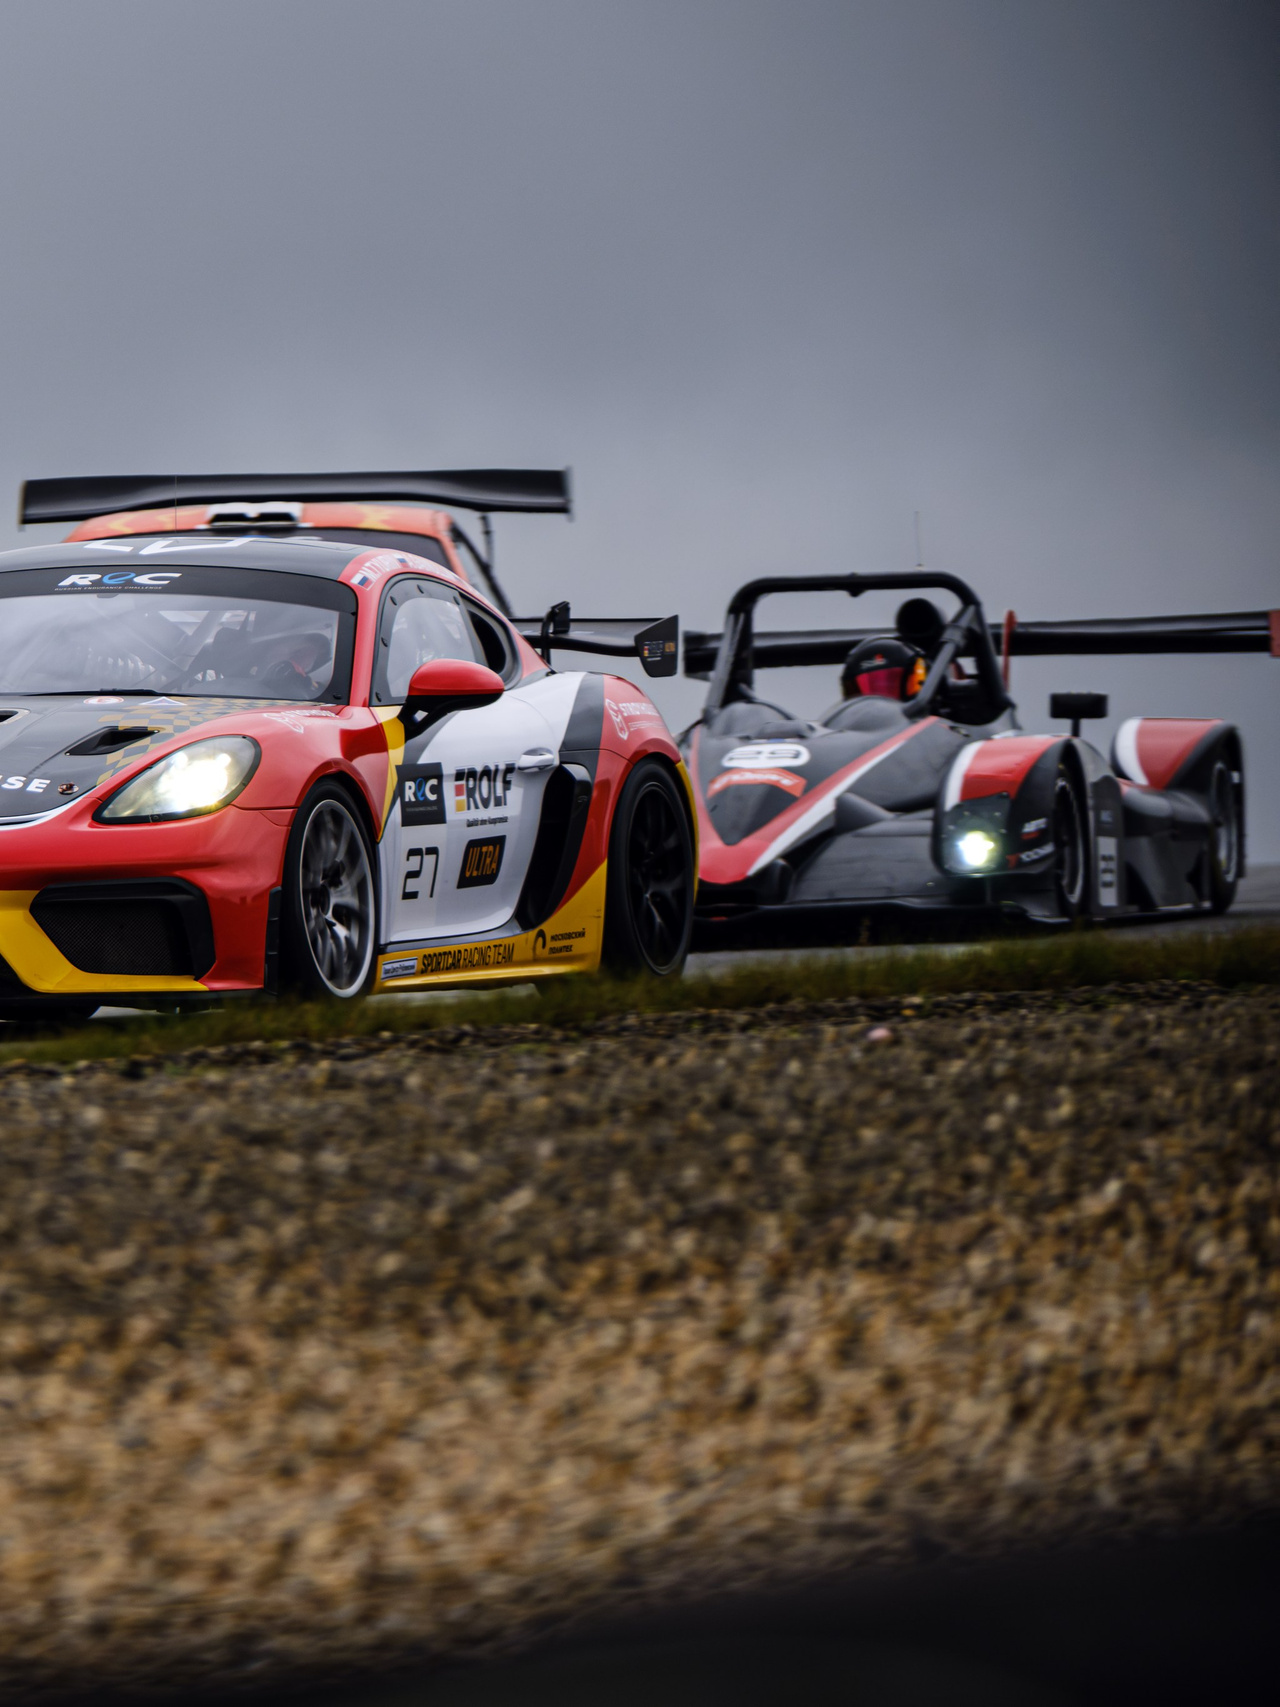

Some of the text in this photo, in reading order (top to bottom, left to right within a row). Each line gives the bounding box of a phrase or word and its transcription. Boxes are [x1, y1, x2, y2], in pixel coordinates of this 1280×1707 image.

[465, 763, 516, 811] ROLF
[401, 846, 440, 900] 27
[465, 844, 500, 878] ULTRA
[420, 949, 463, 975] SPORTCAR
[462, 945, 492, 969] RACING
[492, 942, 515, 965] TEAM
